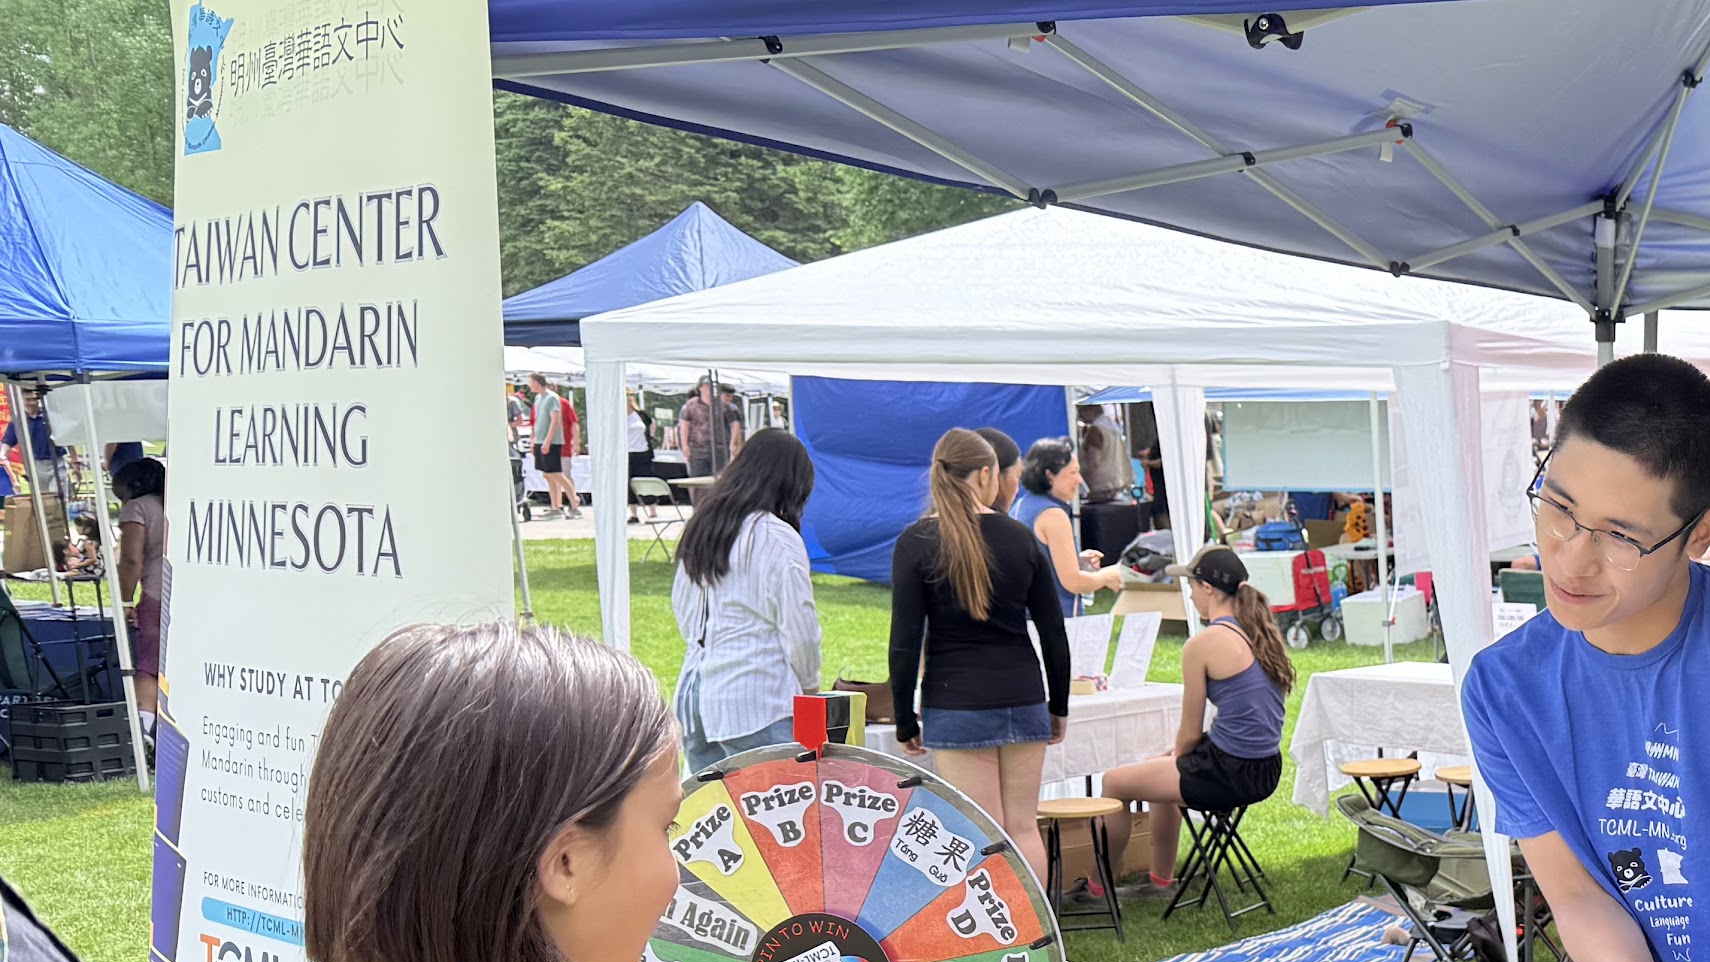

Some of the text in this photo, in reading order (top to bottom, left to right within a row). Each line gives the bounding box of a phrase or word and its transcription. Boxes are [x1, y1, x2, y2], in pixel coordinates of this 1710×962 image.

[230, 14, 404, 97] 明州臺灣華語文中心
[174, 184, 447, 289] TAIWAN CENTER
[180, 300, 418, 377] FOR MANDARIN
[213, 402, 368, 468] LEARNING
[187, 499, 402, 578] MINNESOTA
[205, 662, 313, 700] WHY STUDY AT
[203, 716, 252, 750] Engaging
[258, 725, 280, 748] and
[286, 727, 305, 752] fun
[202, 750, 306, 793] Mandarin through
[201, 787, 270, 815] customs and
[742, 785, 813, 816] Prize
[824, 784, 897, 814] Prize
[1605, 787, 1686, 819] 華語文中心
[673, 806, 730, 861] Prize
[777, 820, 802, 844] B
[847, 822, 868, 844] C
[717, 849, 742, 872] A
[203, 872, 219, 887] FOR
[222, 877, 245, 895] MORE
[967, 872, 1016, 943] Prize
[1634, 895, 1693, 912] Culture
[681, 902, 750, 950] Again
[779, 923, 804, 940] TO
[809, 920, 850, 940] WIN
[951, 910, 976, 936] D
[1650, 915, 1690, 930] Language
[1666, 933, 1691, 946] Fun
